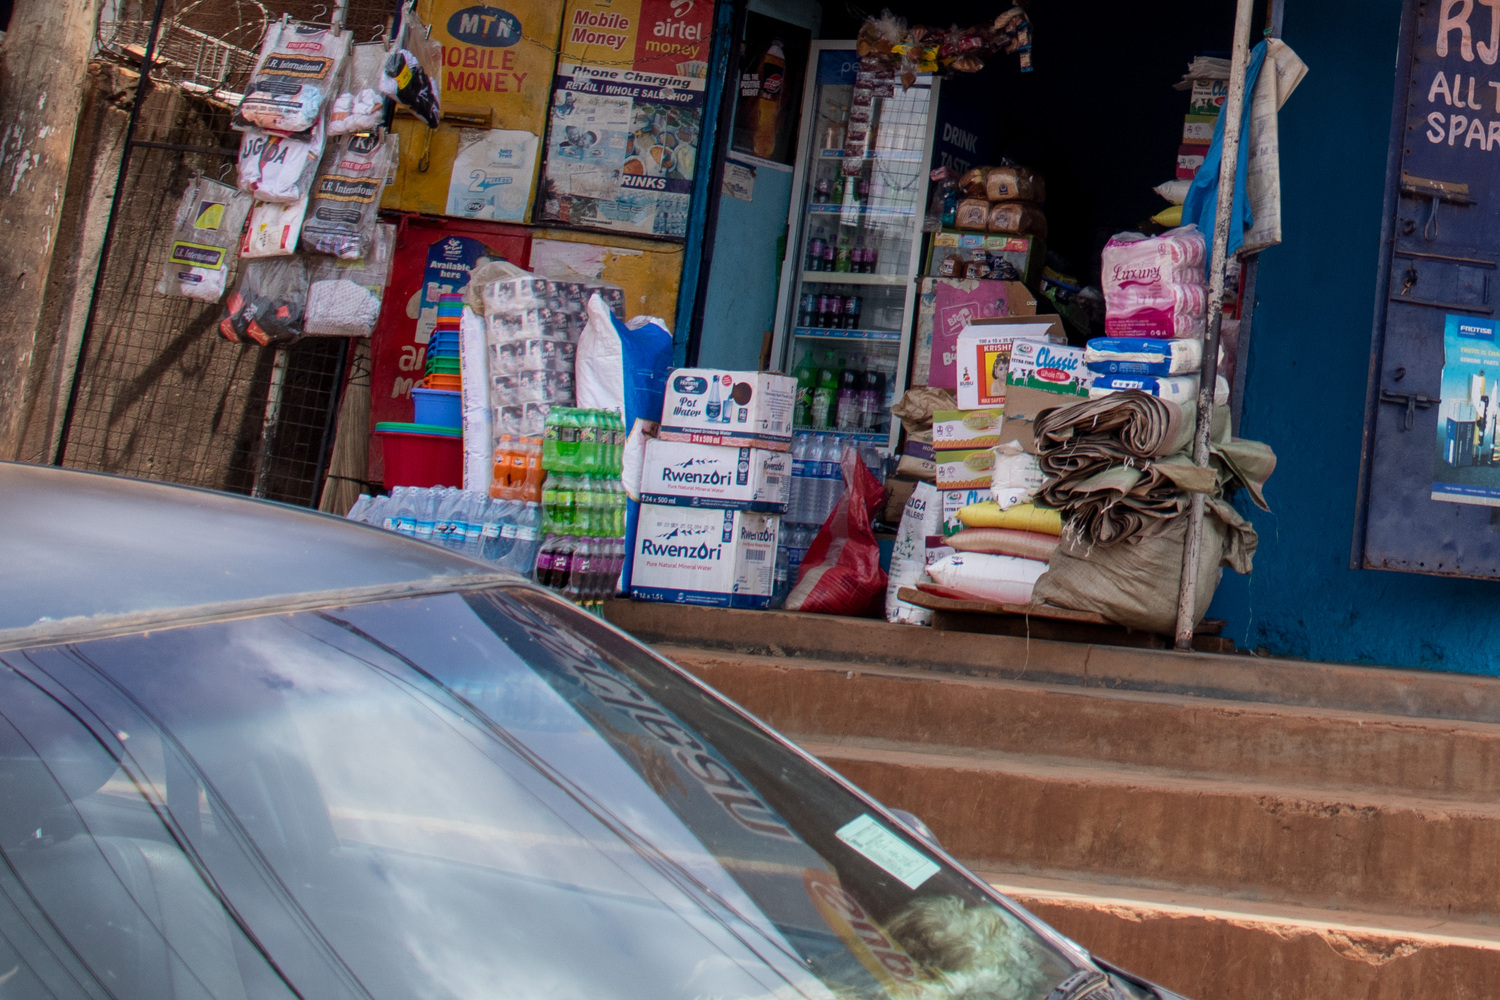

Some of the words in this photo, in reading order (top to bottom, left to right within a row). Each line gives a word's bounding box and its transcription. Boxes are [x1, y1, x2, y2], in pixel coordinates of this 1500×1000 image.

[459, 13, 513, 37] MTN
[573, 10, 629, 30] Mobile
[653, 18, 702, 40] airtel
[571, 28, 627, 50] Money
[645, 40, 700, 58] money
[446, 71, 528, 93] MONEY
[572, 66, 619, 79] Phone
[624, 71, 691, 89] Charging
[565, 81, 598, 92] RETAIL
[605, 85, 639, 97] WHOLE
[1428, 70, 1482, 111] ALL
[942, 122, 979, 154] DRINK
[468, 169, 487, 192] 2
[430, 260, 470, 271] Available
[440, 270, 461, 279] here
[1112, 264, 1162, 281] Luxury
[1460, 325, 1492, 335] FROTISE
[1036, 346, 1079, 371] Classic
[673, 406, 702, 416] Water
[679, 397, 698, 407] Pot
[662, 467, 732, 485] Rwenzori
[641, 539, 722, 560] Rwenzori
[658, 561, 677, 569] Natural
